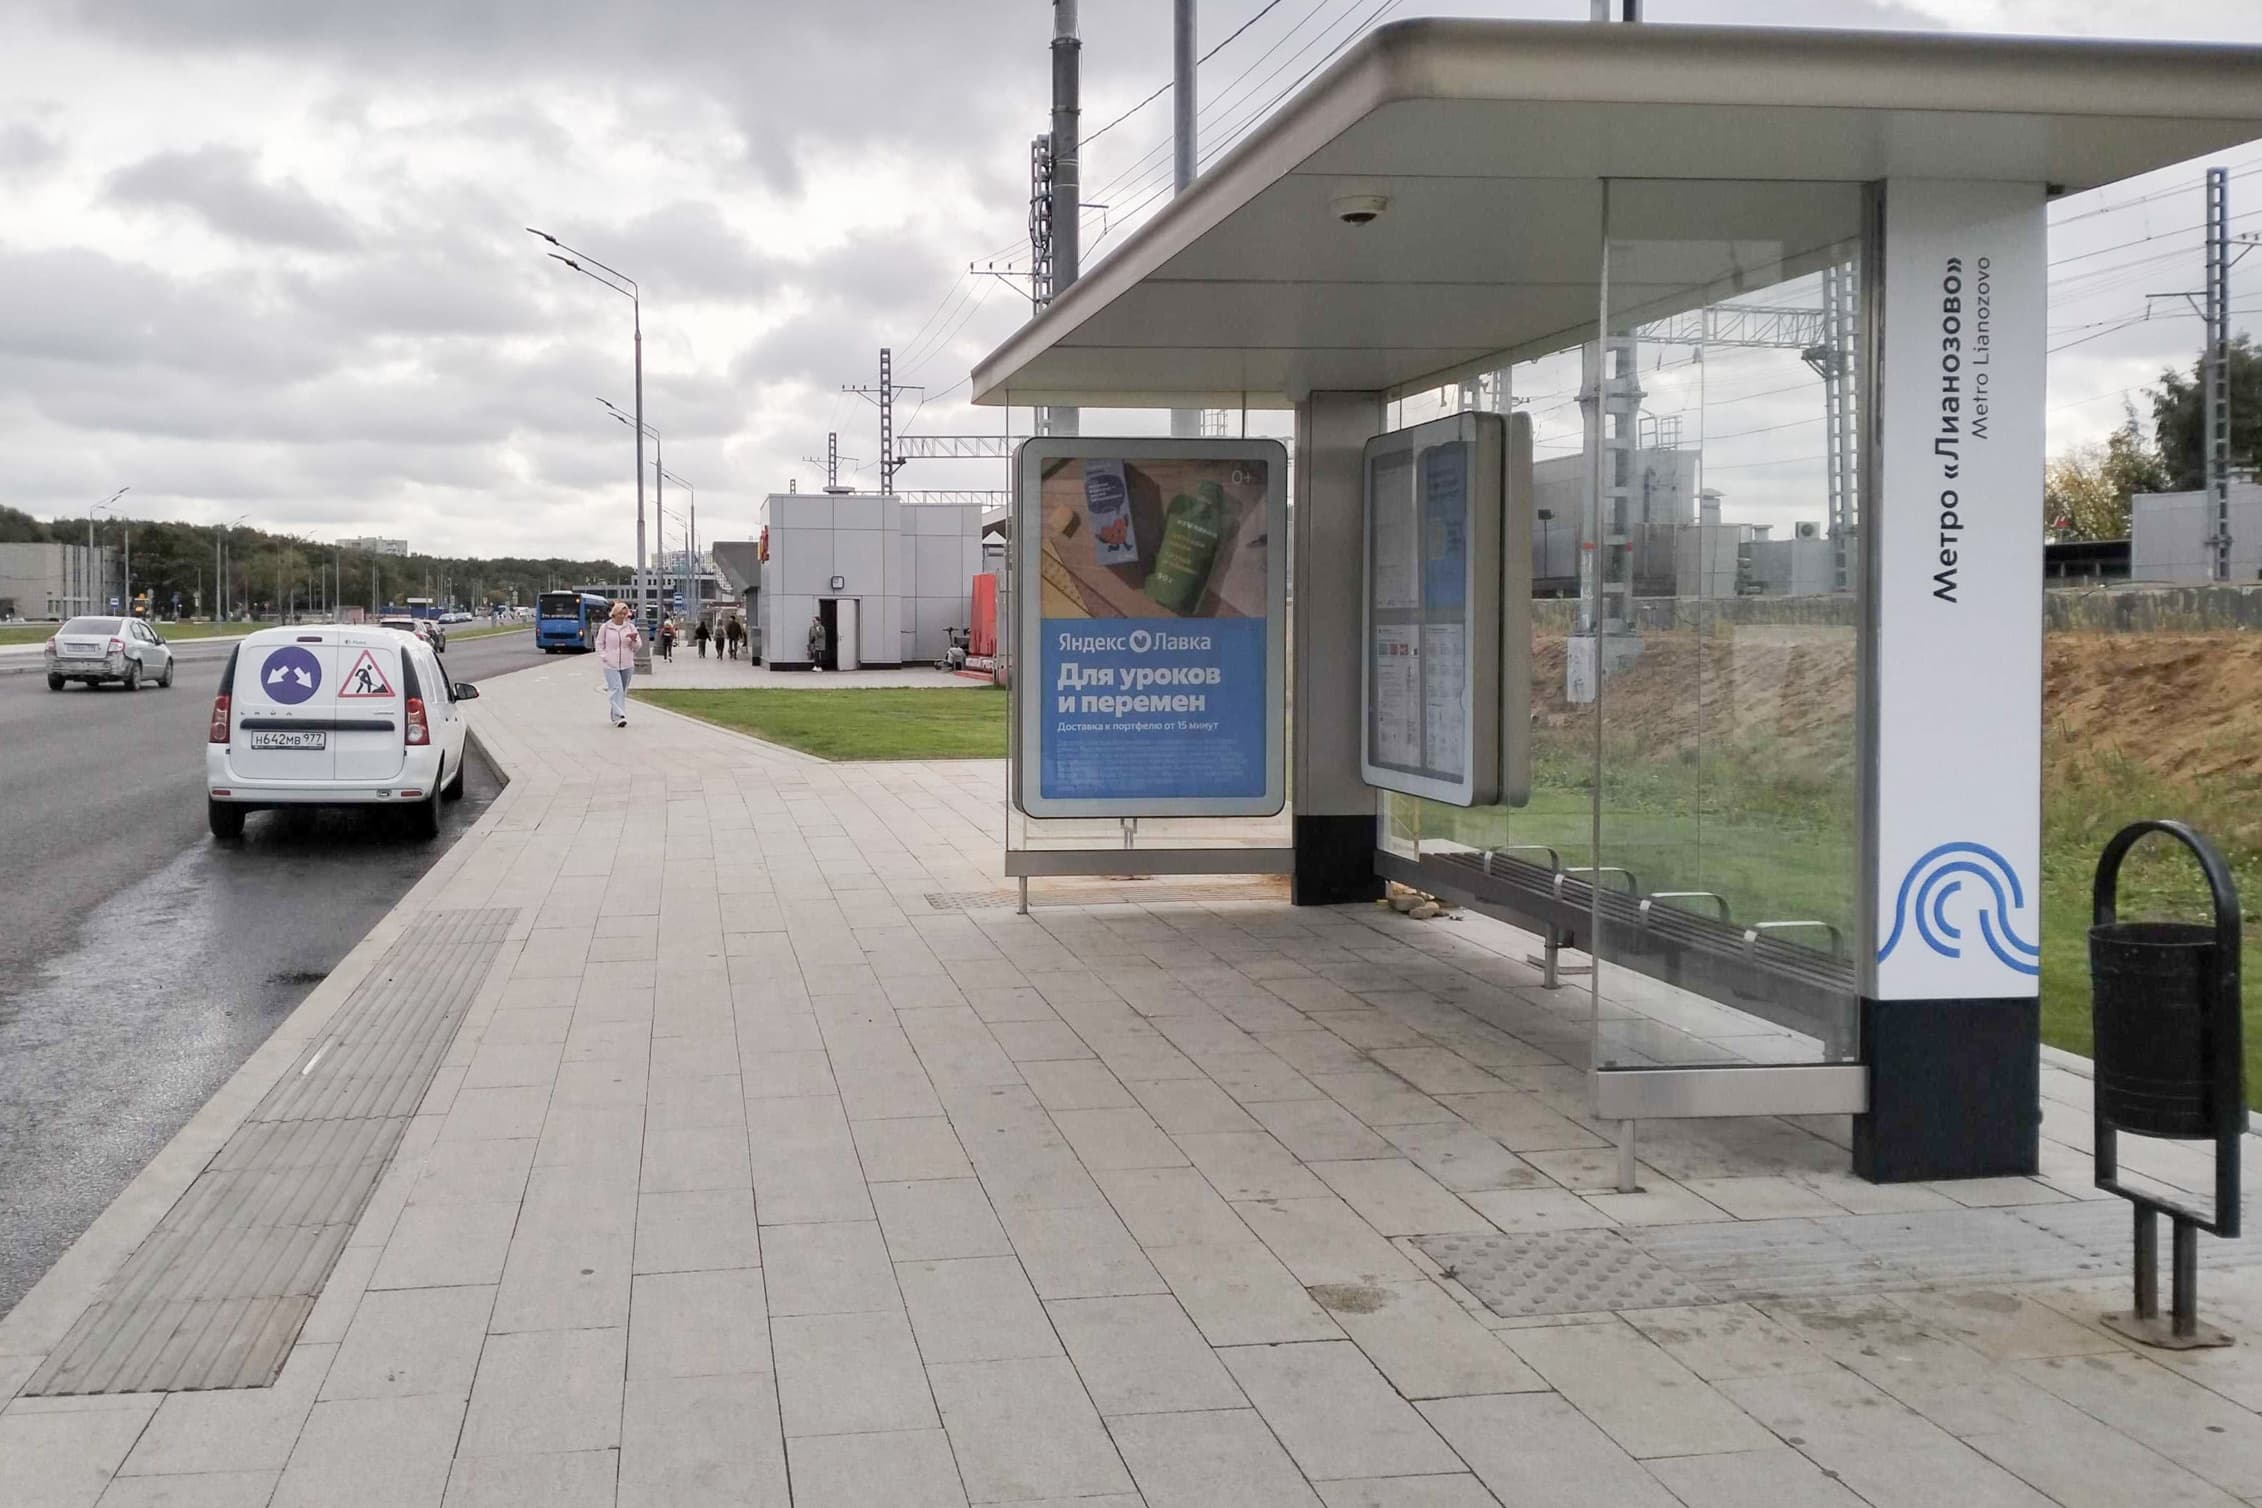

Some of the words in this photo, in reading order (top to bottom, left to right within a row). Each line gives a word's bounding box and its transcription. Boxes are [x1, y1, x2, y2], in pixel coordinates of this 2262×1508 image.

[1973, 257, 1990, 364] Lianozovo
[1935, 257, 1962, 479] «Лианозово»
[1971, 373, 1988, 439] Metro
[1231, 470, 1251, 485] 0+
[1933, 490, 1964, 603] Метро
[1058, 633, 1126, 653] Яндекс
[1153, 632, 1212, 650] Лавка
[1057, 662, 1114, 690] Для
[1120, 667, 1221, 690] уроков
[1058, 695, 1075, 712] и
[1081, 694, 1205, 718] перемен
[255, 733, 301, 745] Н642МВ
[303, 733, 322, 743] 977
[1057, 721, 1104, 733] Доставка
[1105, 723, 1111, 731] к
[1112, 720, 1163, 733] портфелю
[1164, 722, 1175, 730] от
[1178, 720, 1187, 730] 15
[1189, 721, 1219, 731] минут
